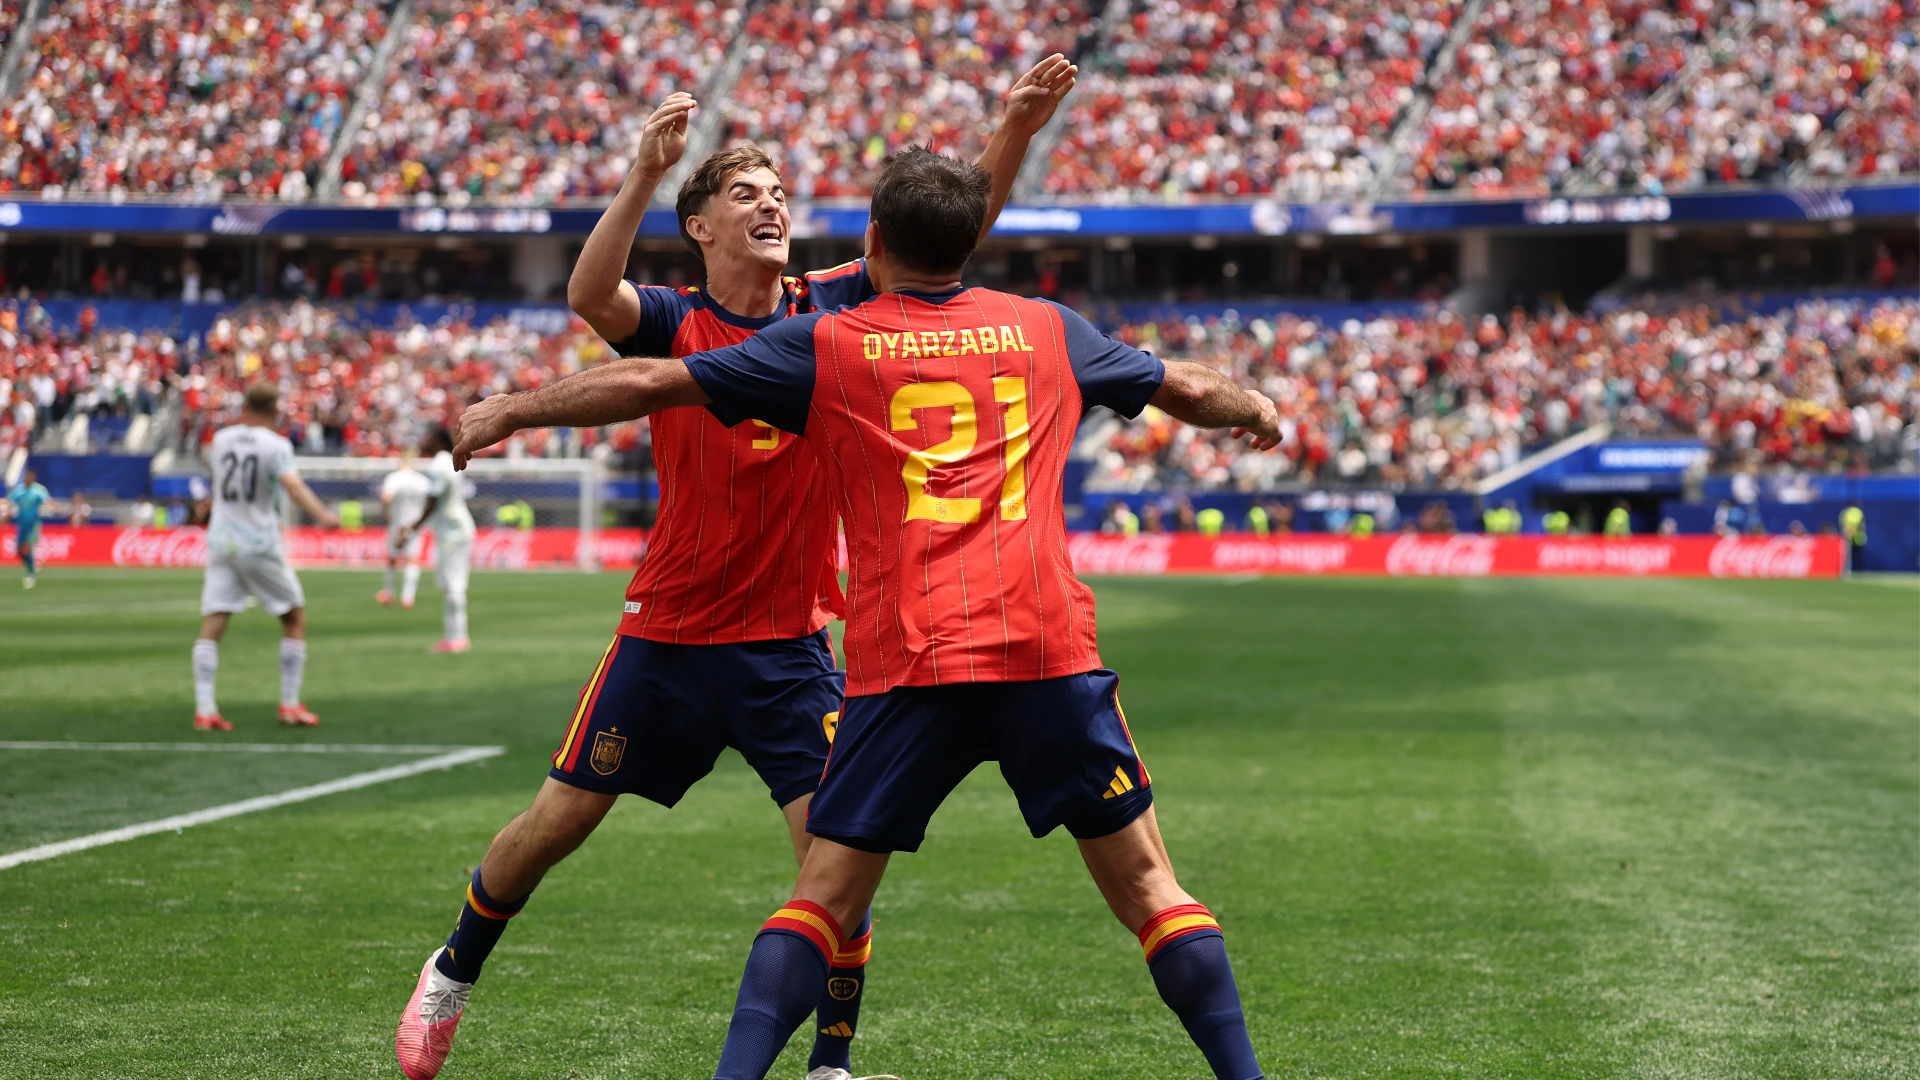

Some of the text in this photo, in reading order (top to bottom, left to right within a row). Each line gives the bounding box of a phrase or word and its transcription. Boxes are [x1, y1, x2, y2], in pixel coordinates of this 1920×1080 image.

[863, 325, 1034, 360] OYARZABAL
[890, 377, 1031, 524] 21
[221, 451, 259, 503] 20
[1385, 532, 1497, 576] Coca-Cola
[1708, 532, 1817, 578] Coca-Cola
